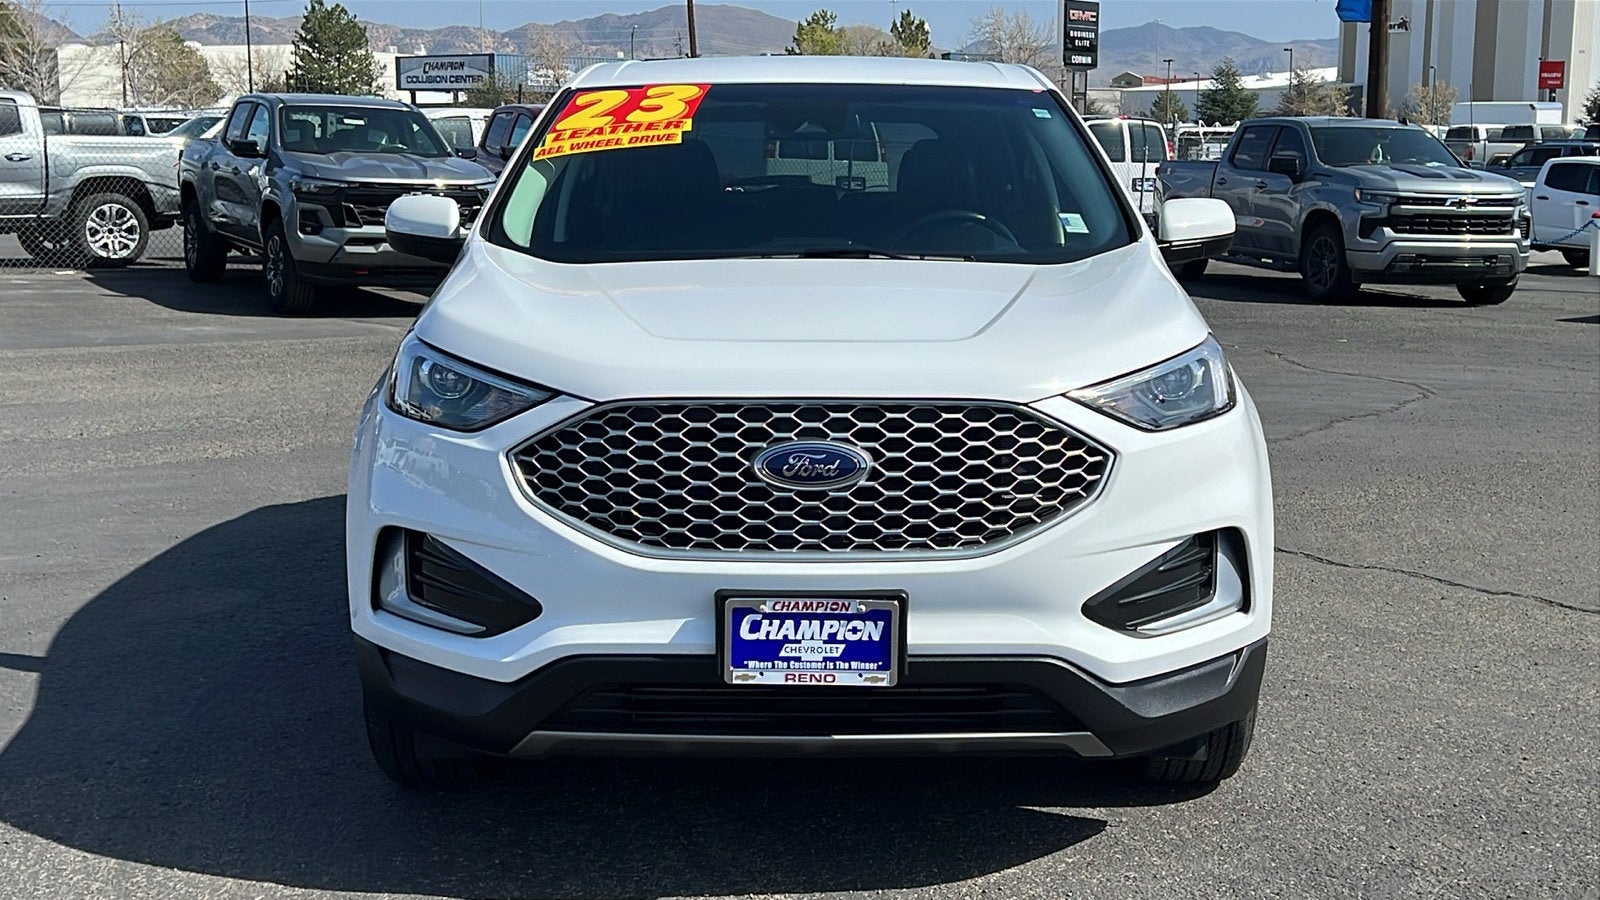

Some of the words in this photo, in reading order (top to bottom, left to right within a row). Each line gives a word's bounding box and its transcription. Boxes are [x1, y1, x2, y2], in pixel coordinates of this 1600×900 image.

[1069, 10, 1097, 21] GMC
[1069, 30, 1095, 39] BUSINESS
[1075, 39, 1090, 47] ELITE
[423, 61, 465, 74] CHAMPION
[406, 75, 448, 84] COLLISION
[448, 75, 483, 84] CENTER
[555, 85, 703, 131] 23
[551, 120, 686, 143] LEATHER
[535, 145, 566, 158] ALL
[570, 137, 624, 151] WHEEL
[627, 133, 678, 145] DRIVE
[782, 453, 841, 477] Ford
[772, 601, 851, 612] CHAMPION
[739, 613, 885, 642] CHAMPION
[783, 645, 840, 654] CHEVROLET
[774, 660, 788, 669] The
[789, 660, 826, 669] Customer
[835, 660, 850, 669] The
[784, 673, 836, 684] RENO
